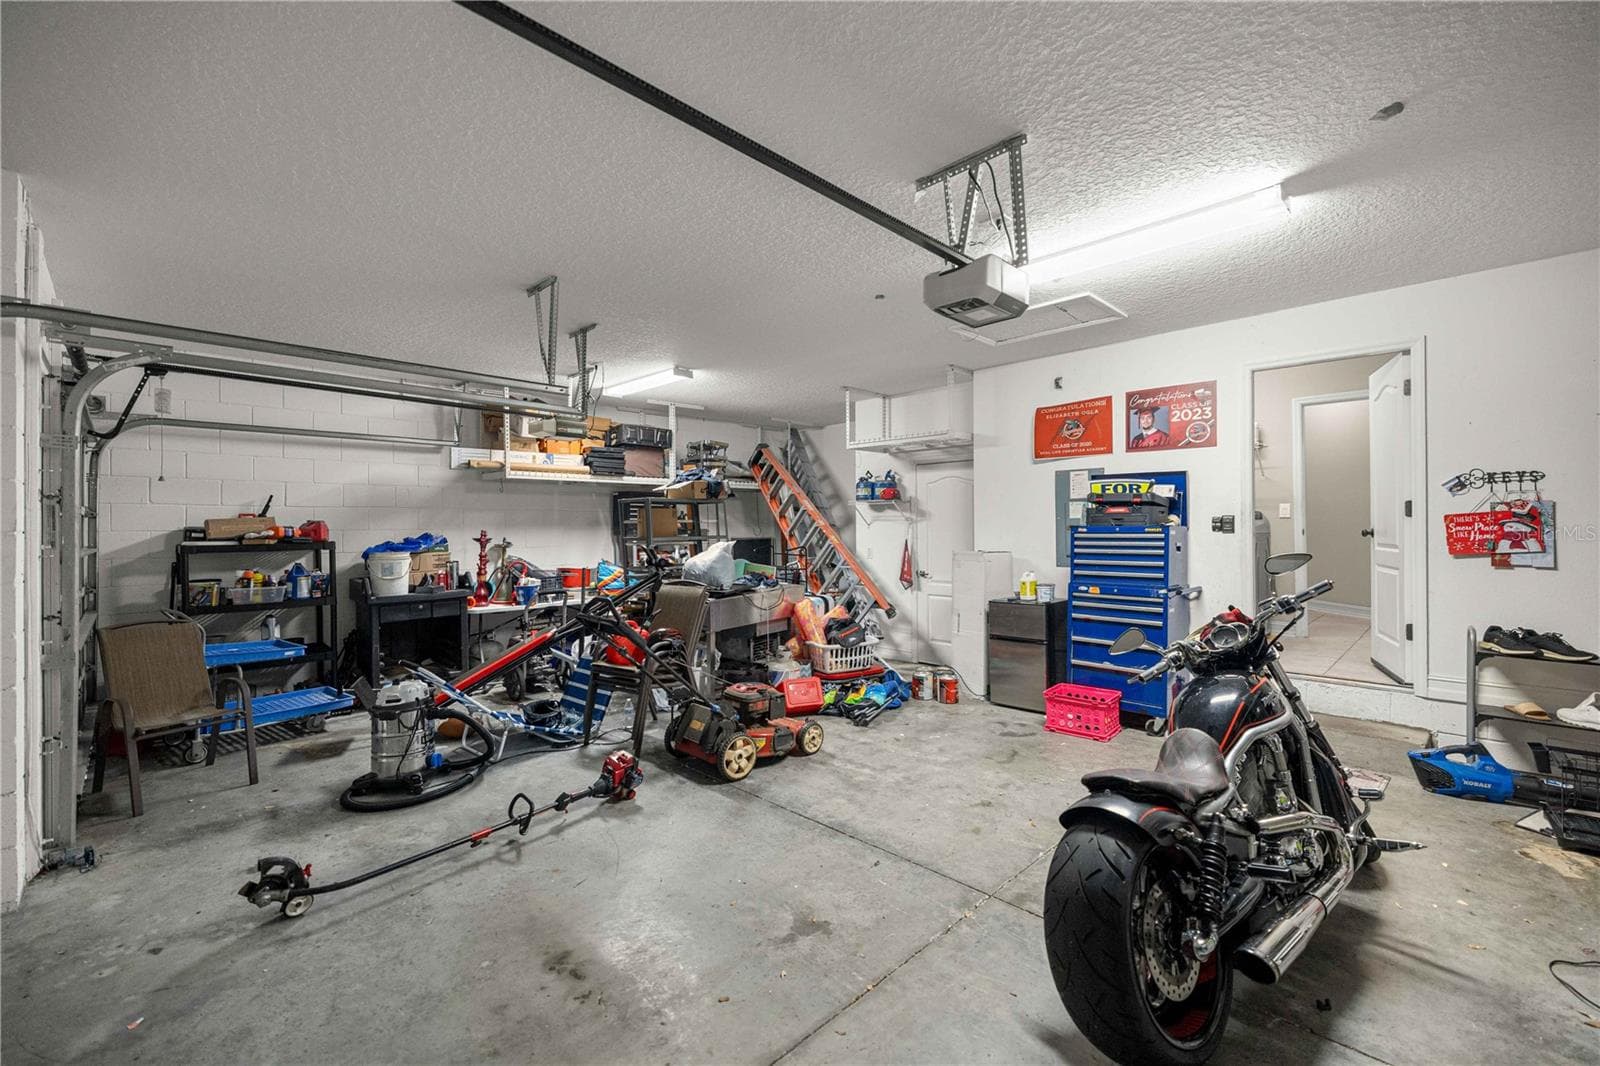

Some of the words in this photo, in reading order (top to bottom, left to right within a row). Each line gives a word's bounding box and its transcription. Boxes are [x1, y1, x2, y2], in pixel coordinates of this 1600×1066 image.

[1130, 391, 1193, 407] Congratulations
[1170, 401, 1197, 410] CLASS
[1170, 407, 1212, 422] 2023
[1487, 471, 1539, 483] KEYS
[1101, 484, 1141, 494] FOR
[1448, 523, 1474, 533] Snow
[1474, 521, 1499, 532] Place
[1469, 530, 1496, 541] Home
